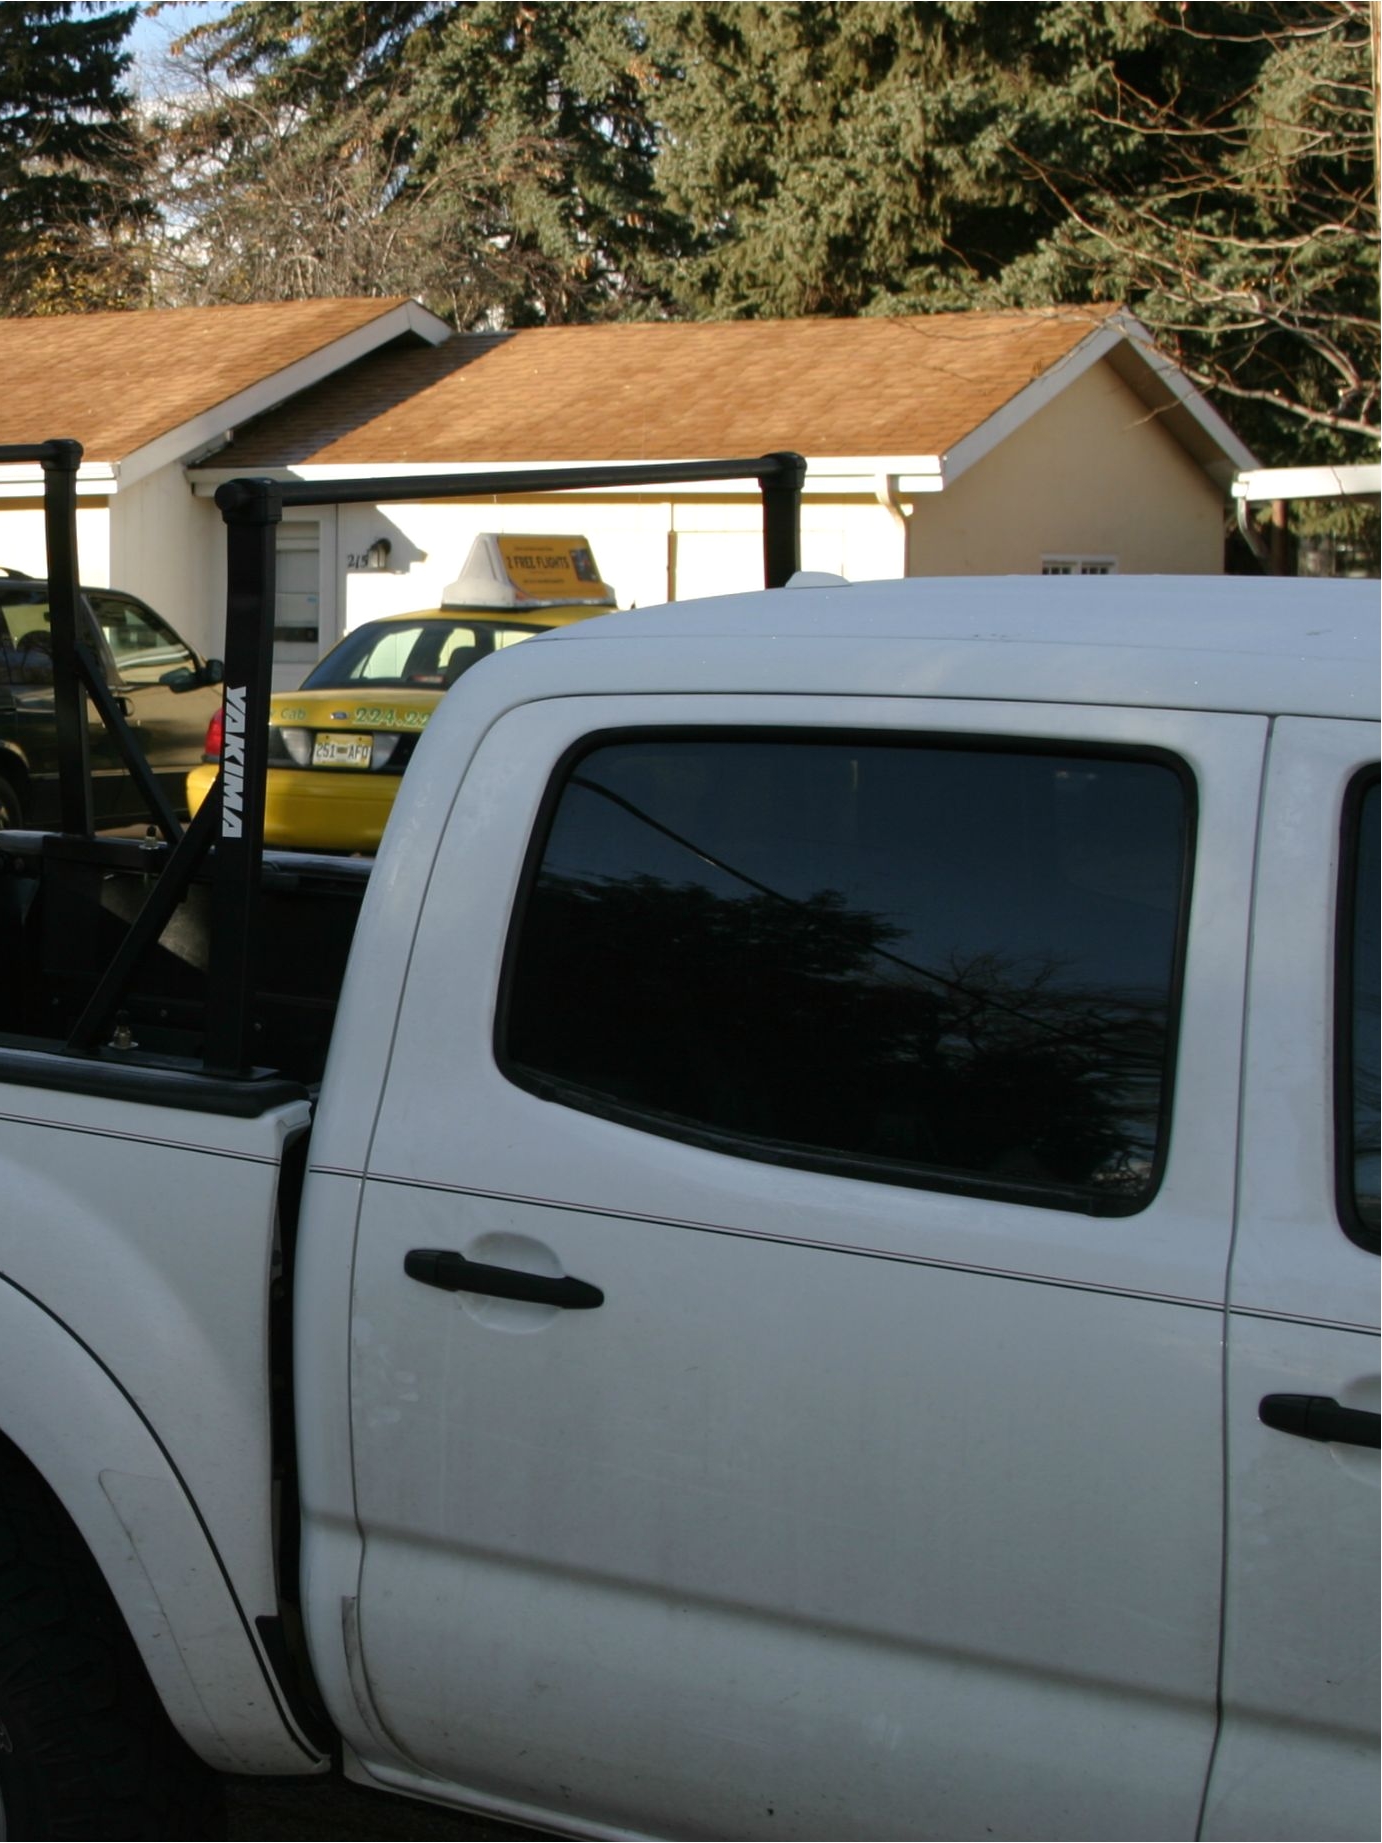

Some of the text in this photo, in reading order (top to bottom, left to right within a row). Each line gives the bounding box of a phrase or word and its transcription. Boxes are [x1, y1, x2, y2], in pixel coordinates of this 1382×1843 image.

[514, 556, 536, 569] FREE
[537, 556, 570, 569] FLIGHTS
[281, 707, 306, 720] Cab
[222, 686, 247, 838] YAKIMA
